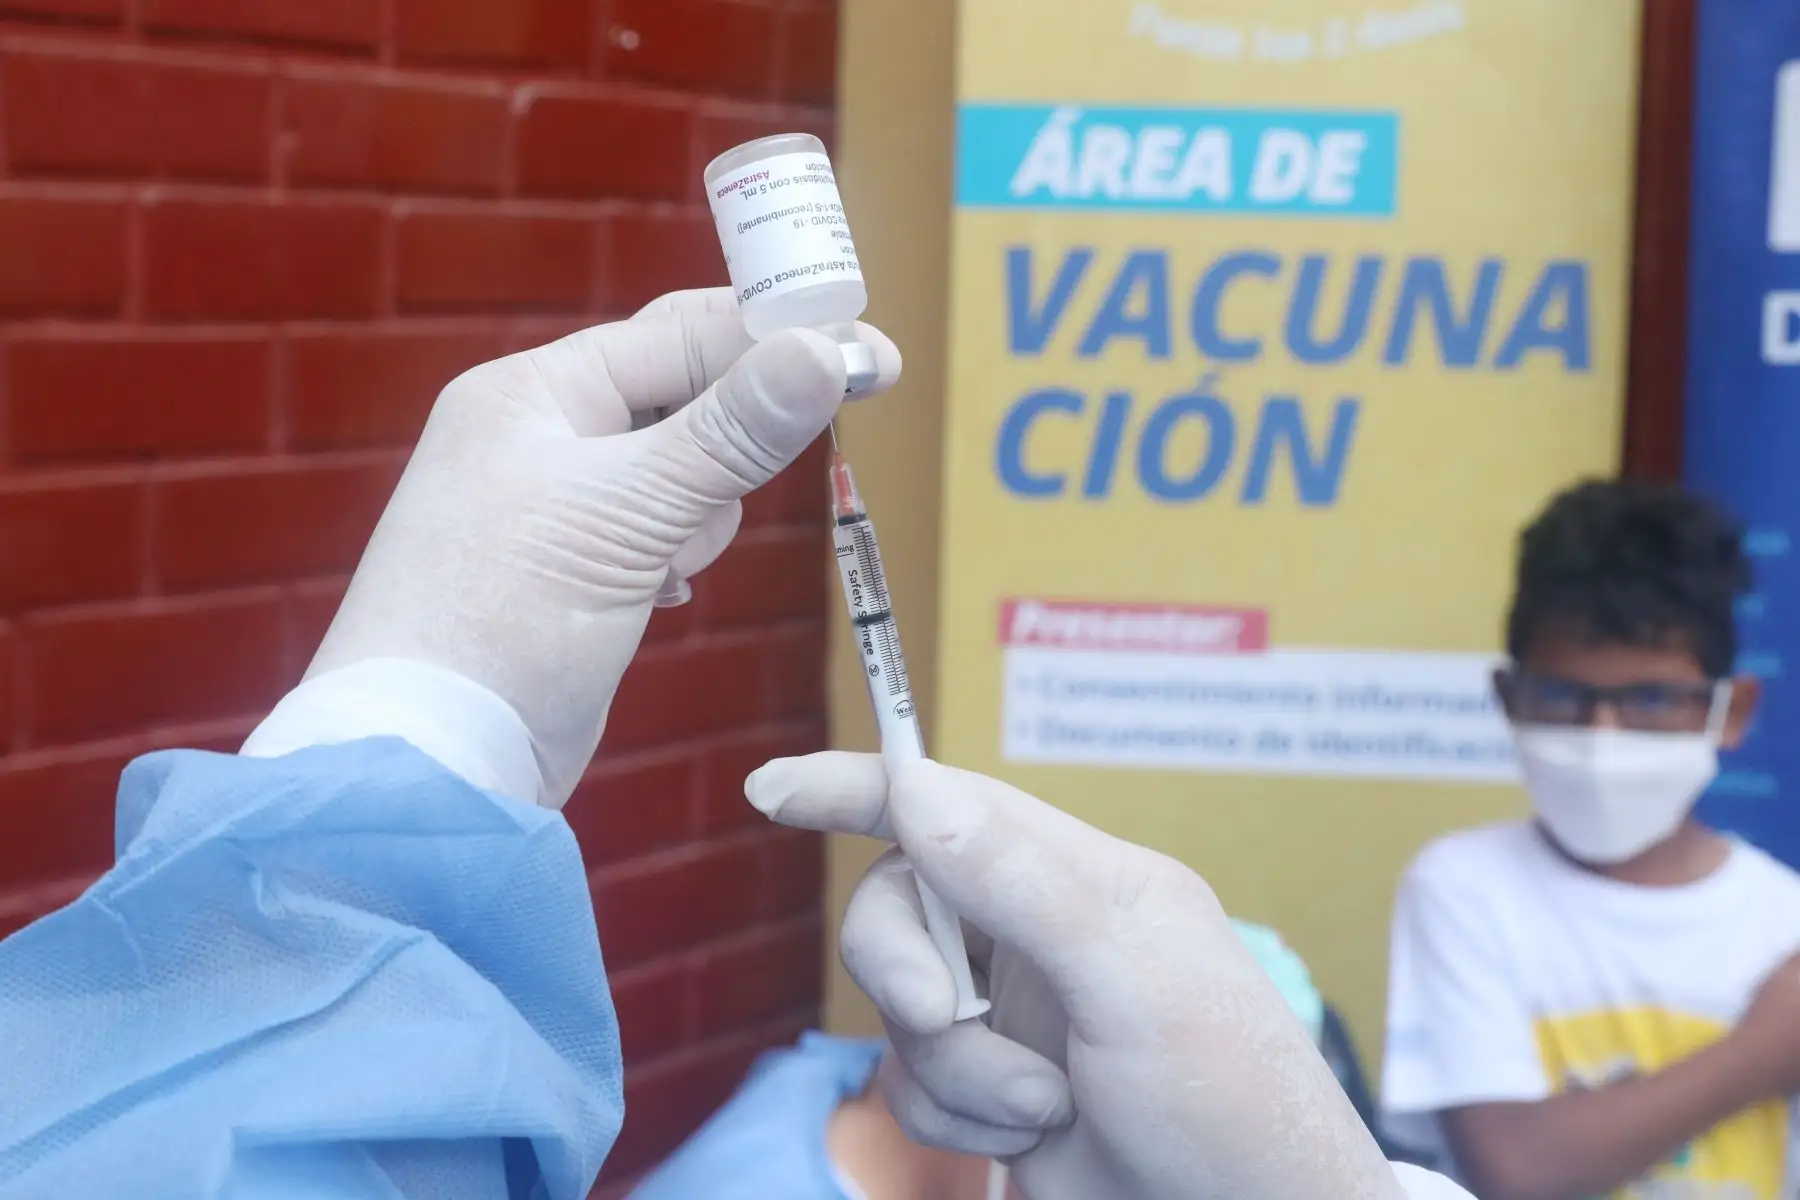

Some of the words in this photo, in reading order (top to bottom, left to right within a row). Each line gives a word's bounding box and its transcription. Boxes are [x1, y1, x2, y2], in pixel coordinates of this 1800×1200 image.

[1010, 107, 1233, 200] ÁREA
[1247, 128, 1368, 205] DE
[716, 169, 770, 199] AstraZeneca
[740, 188, 757, 200] mL
[760, 184, 767, 194] 5
[769, 178, 791, 190] con
[774, 260, 846, 284] AstraZeneca
[1004, 247, 1593, 373] VACUNA
[993, 372, 1361, 507] CIÓN
[848, 569, 863, 608] Safety
[857, 610, 874, 656] Sringe
